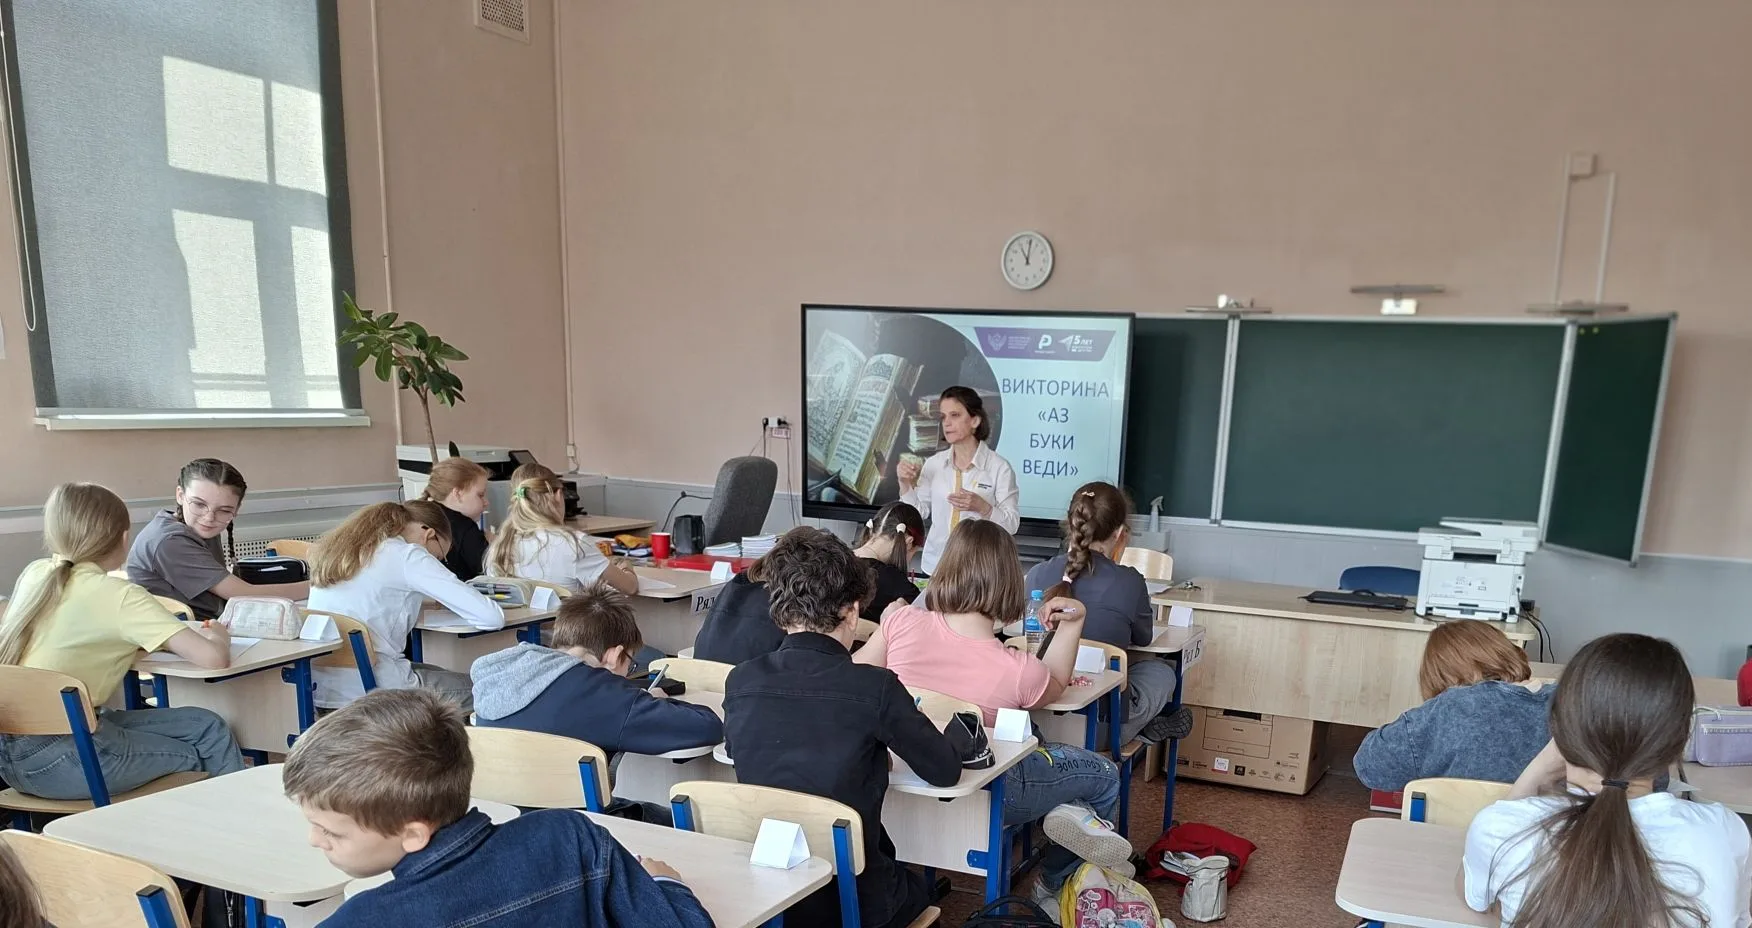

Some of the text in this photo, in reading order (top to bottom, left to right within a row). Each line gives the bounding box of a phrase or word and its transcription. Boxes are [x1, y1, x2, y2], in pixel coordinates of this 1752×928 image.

[1002, 378, 1109, 398] ВИКТОРИНА
[1038, 407, 1069, 423] «АЗ
[1030, 433, 1074, 450] БУКИ
[1023, 459, 1079, 479] ВЕДИ»
[1056, 759, 1101, 773] COOL DUDE
